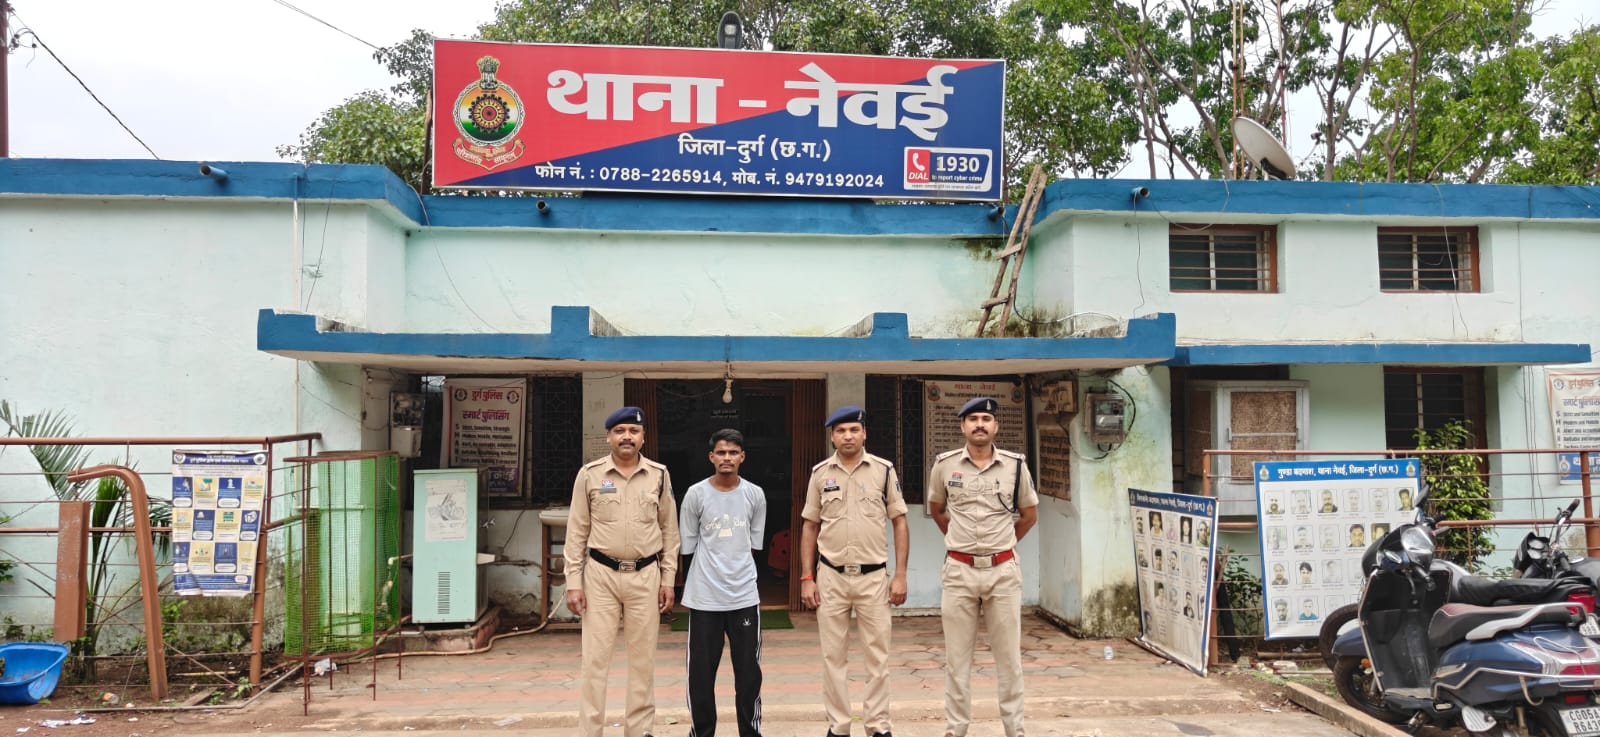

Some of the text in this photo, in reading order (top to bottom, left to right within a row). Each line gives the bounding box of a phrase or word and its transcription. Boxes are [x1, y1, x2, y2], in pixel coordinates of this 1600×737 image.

[547, 69, 724, 124] थाना
[784, 62, 959, 141] नेवई
[677, 132, 831, 163] जिला-दुर्ग (छ.ग.)
[535, 161, 566, 179] फोन
[569, 161, 585, 180] नं.
[600, 167, 727, 186] 0788-2265914,
[731, 168, 761, 185] मोब.
[765, 168, 780, 185] नं.
[785, 172, 884, 188] 9479192024
[908, 172, 929, 180] DIAL
[936, 156, 980, 173] 1930
